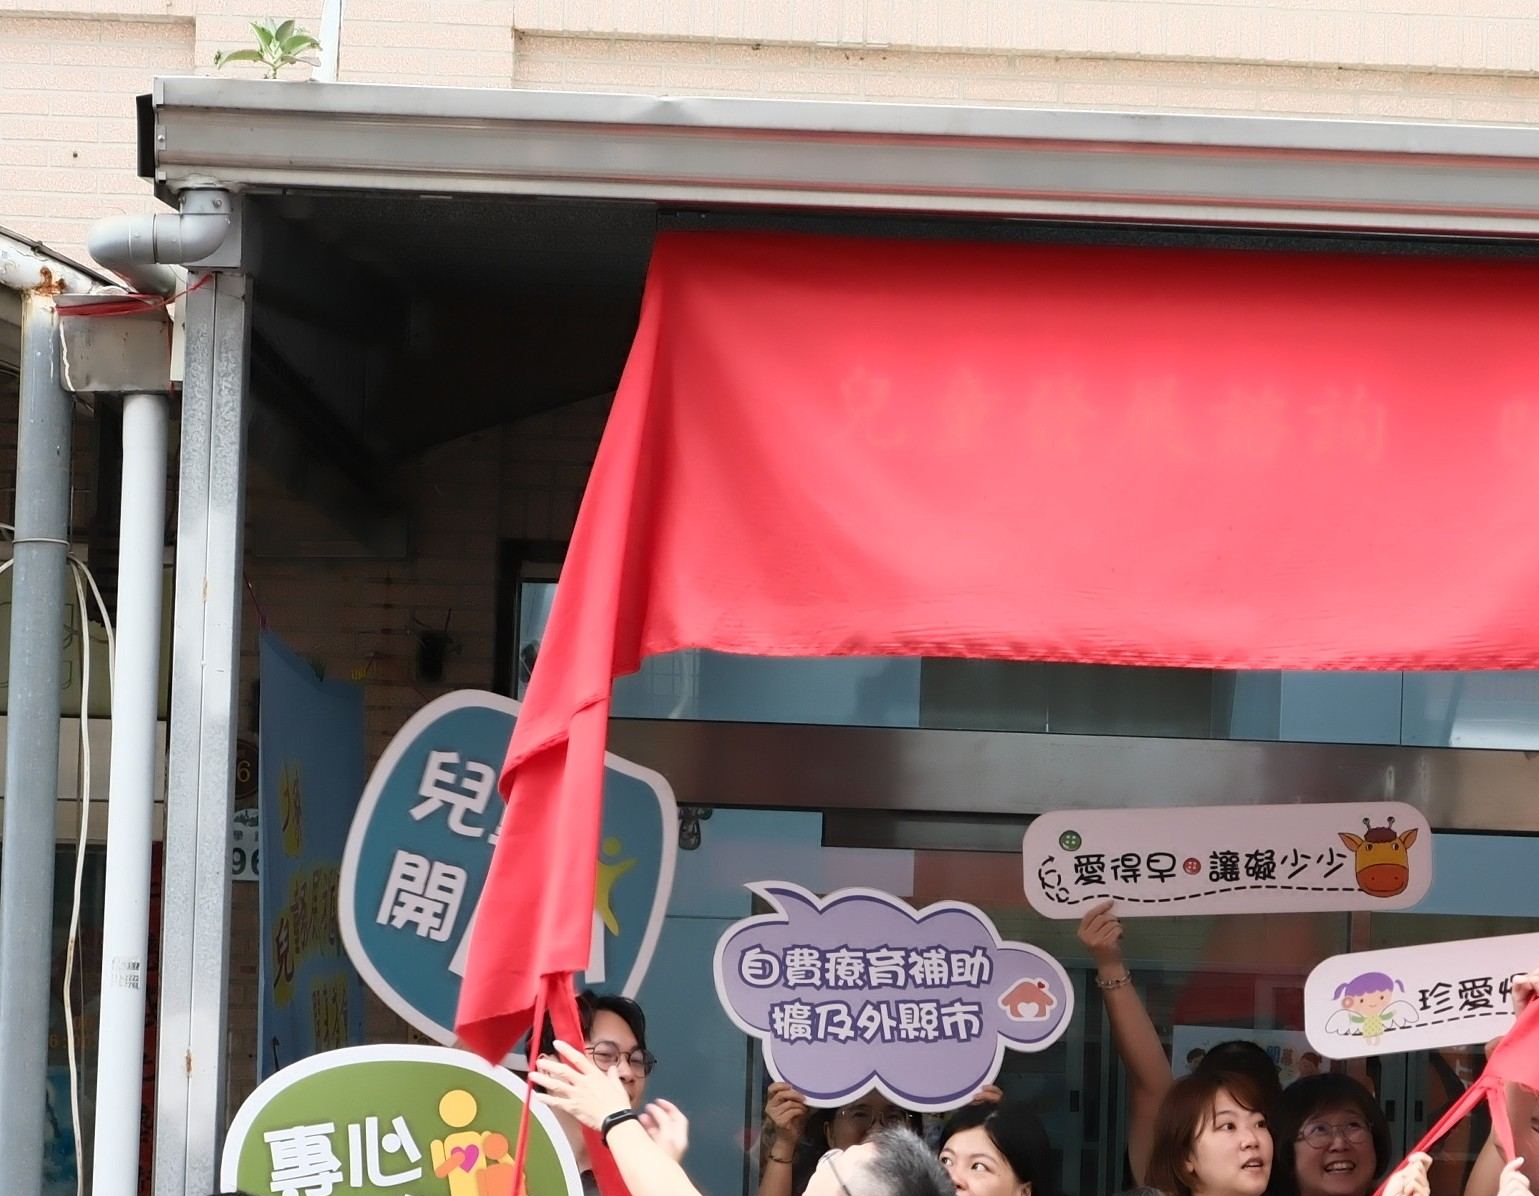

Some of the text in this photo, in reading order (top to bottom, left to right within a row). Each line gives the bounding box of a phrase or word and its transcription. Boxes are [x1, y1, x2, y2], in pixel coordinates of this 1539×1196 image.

[409, 750, 503, 846] 兒
[1073, 848, 1348, 886] 愛得早 讓礙少少
[739, 944, 993, 990] 自費療育補助
[769, 998, 983, 1045] 擴及外縣市
